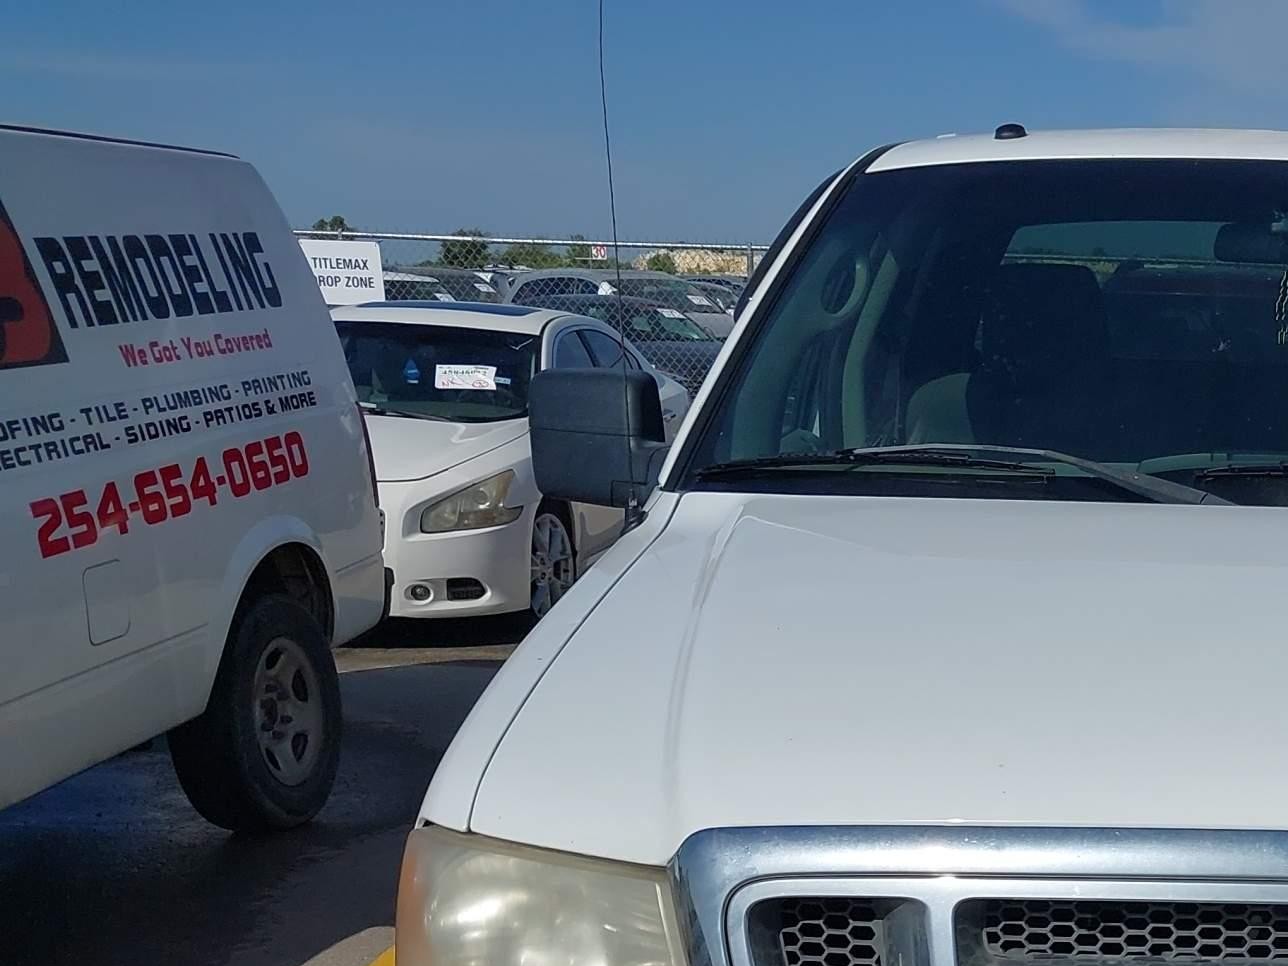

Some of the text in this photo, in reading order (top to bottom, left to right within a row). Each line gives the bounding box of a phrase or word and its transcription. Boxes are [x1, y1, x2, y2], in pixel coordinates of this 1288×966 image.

[32, 231, 283, 329] REMODELING
[310, 256, 370, 271] TITLEMAX
[316, 274, 376, 289] ROP ZONE
[119, 328, 273, 368] We Got You Covered
[80, 401, 129, 426] TILE
[141, 384, 232, 415] PLUMBING
[241, 370, 312, 397] PAINTING
[0, 431, 111, 471] ECTRICAL
[124, 415, 192, 444] SIDING
[203, 401, 263, 428] PATIOS
[265, 401, 277, 416] &
[280, 390, 318, 413] MORE
[29, 431, 309, 559] 254-654-0650
